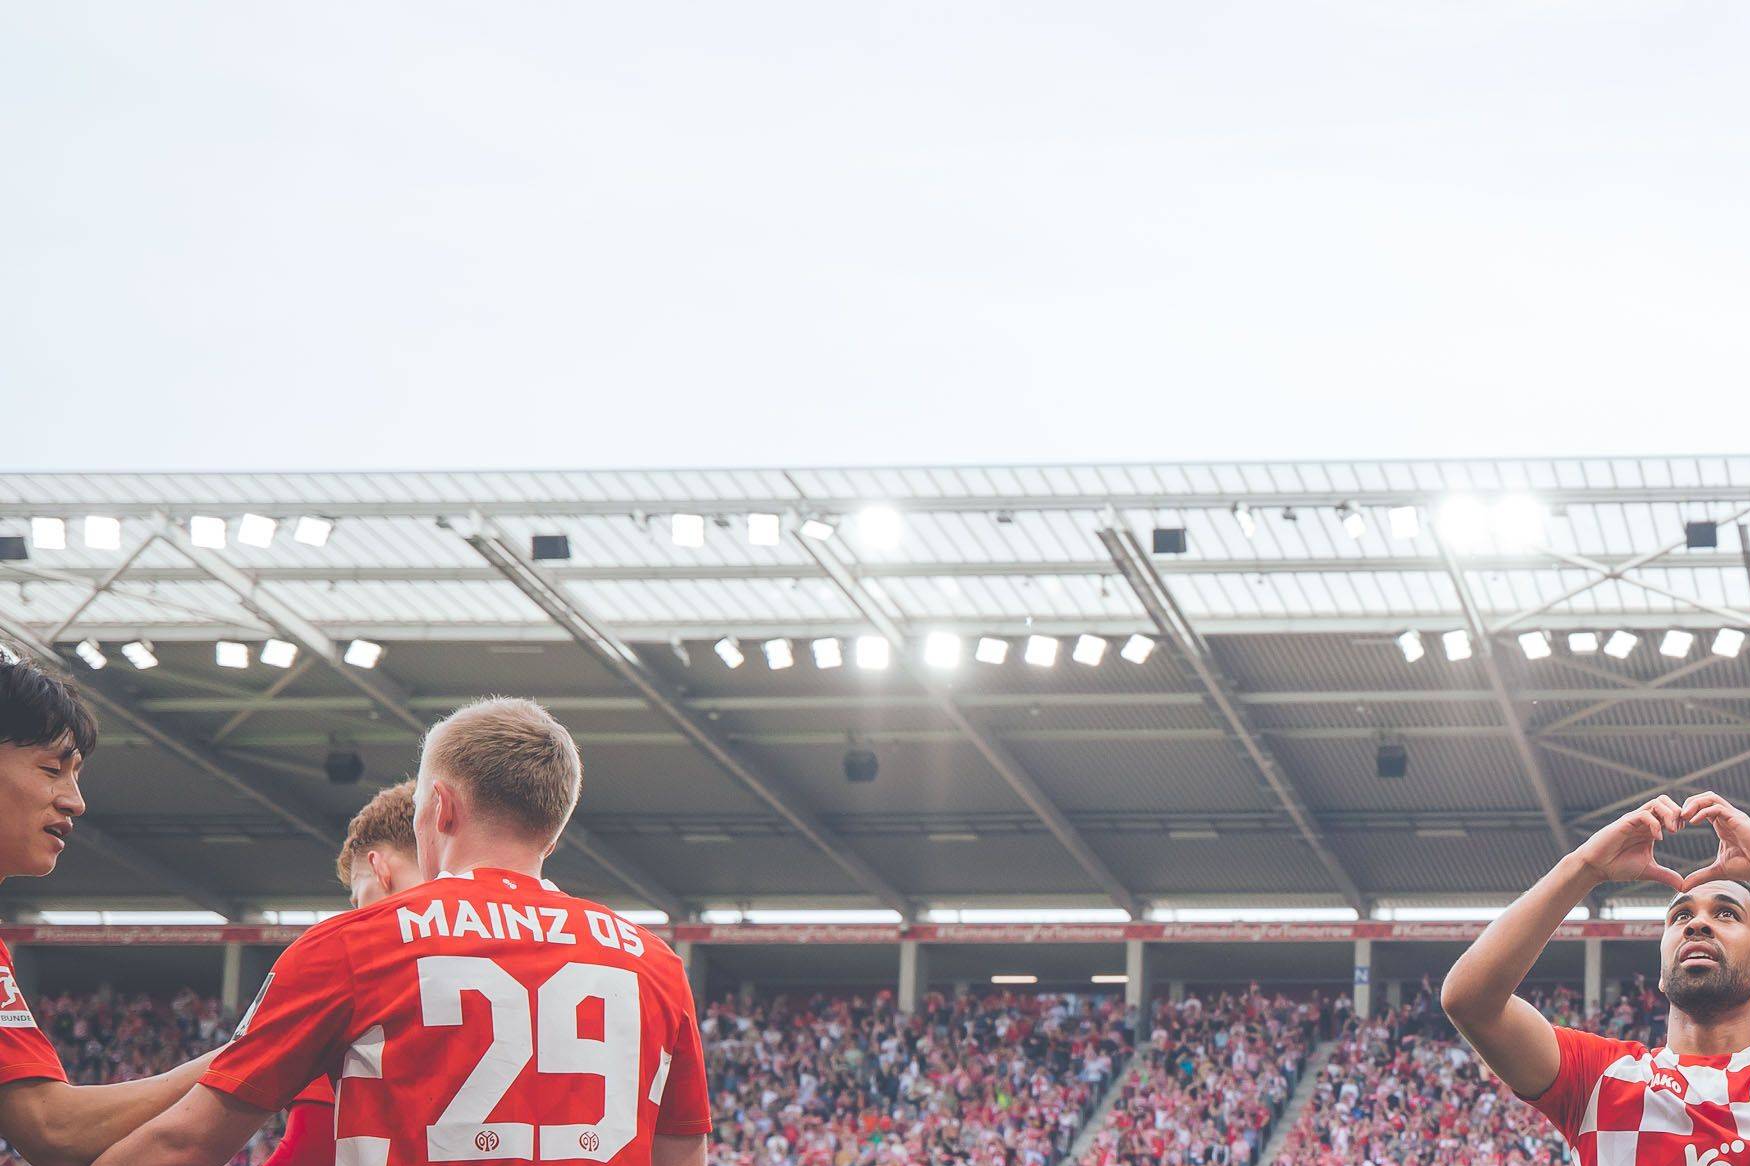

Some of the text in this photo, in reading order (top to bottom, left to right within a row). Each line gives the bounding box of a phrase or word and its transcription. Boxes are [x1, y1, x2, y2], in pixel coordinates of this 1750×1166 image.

[396, 899, 645, 957] MAINZ 05
[416, 955, 641, 1163] 29
[1649, 1072, 1682, 1094] JAKO
